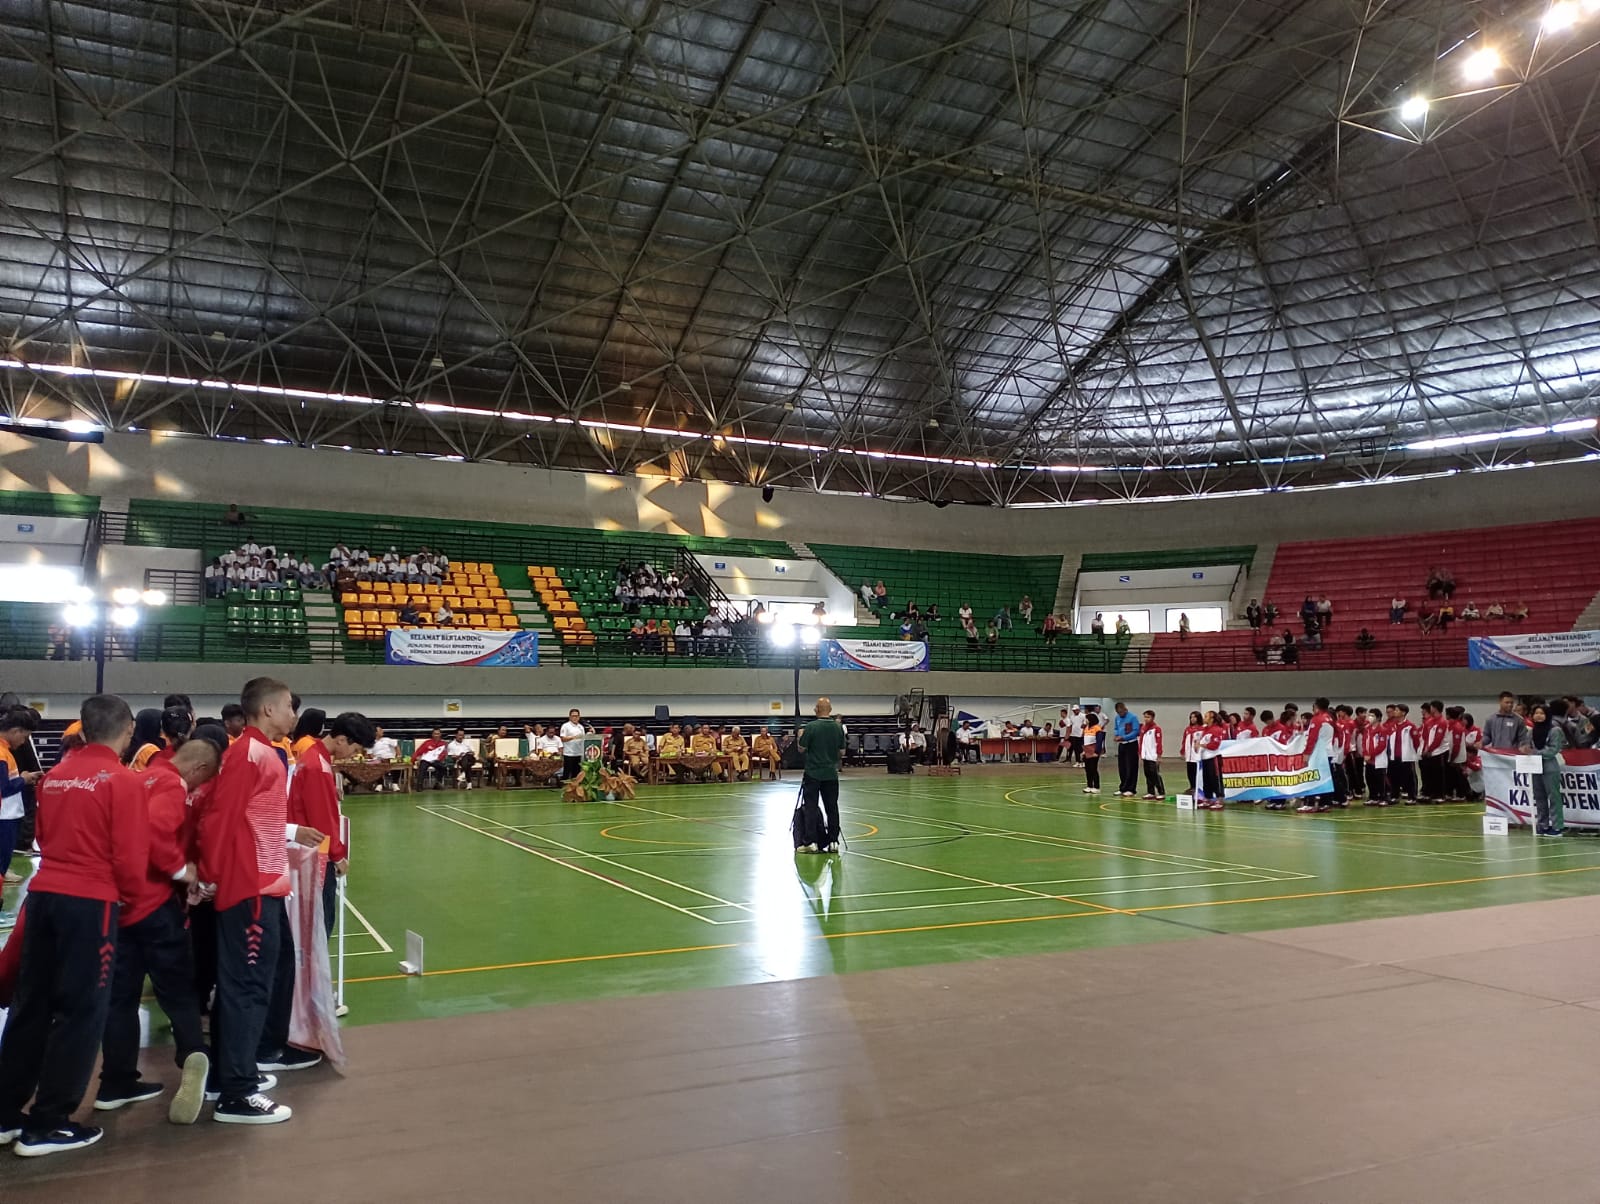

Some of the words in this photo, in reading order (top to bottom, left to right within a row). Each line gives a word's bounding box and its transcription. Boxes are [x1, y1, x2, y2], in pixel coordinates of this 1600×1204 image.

[1222, 755, 1268, 774] NTINGEN
[1269, 754, 1304, 772] POPD
[1222, 777, 1243, 788] PATEN
[1243, 775, 1271, 788] SLEMAN
[1298, 769, 1320, 783] 2024
